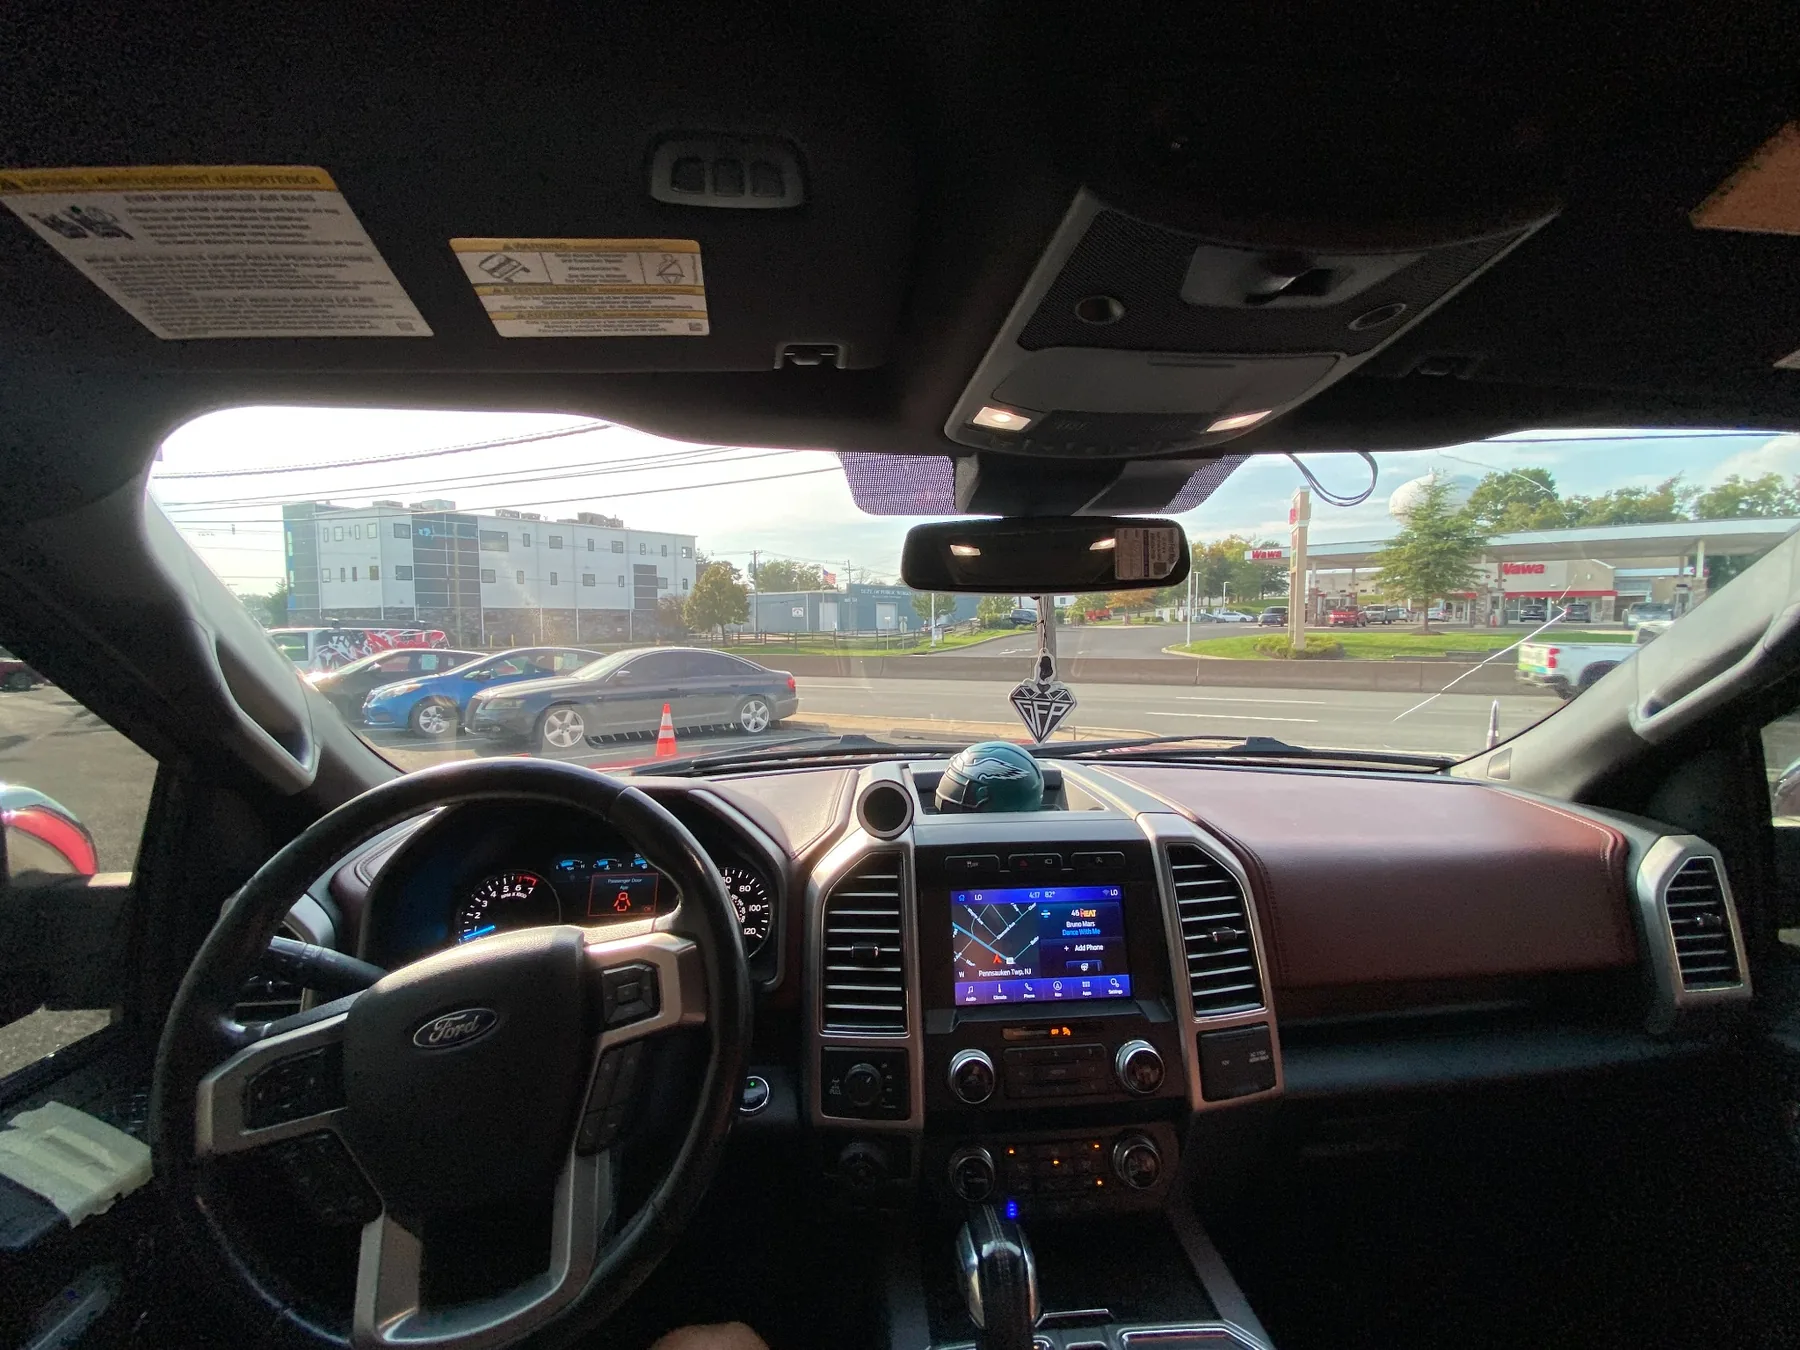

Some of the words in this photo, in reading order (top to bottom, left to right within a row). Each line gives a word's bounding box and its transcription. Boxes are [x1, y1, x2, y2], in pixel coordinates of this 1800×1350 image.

[1252, 550, 1282, 560] Wawa
[503, 885, 509, 893] 5
[527, 887, 534, 895] 7
[1029, 891, 1040, 899] 4:17
[482, 900, 488, 908] 3
[749, 904, 762, 912] 100
[959, 971, 965, 979] W
[979, 970, 1011, 978] Pennsauken
[428, 1014, 480, 1042] Ford
